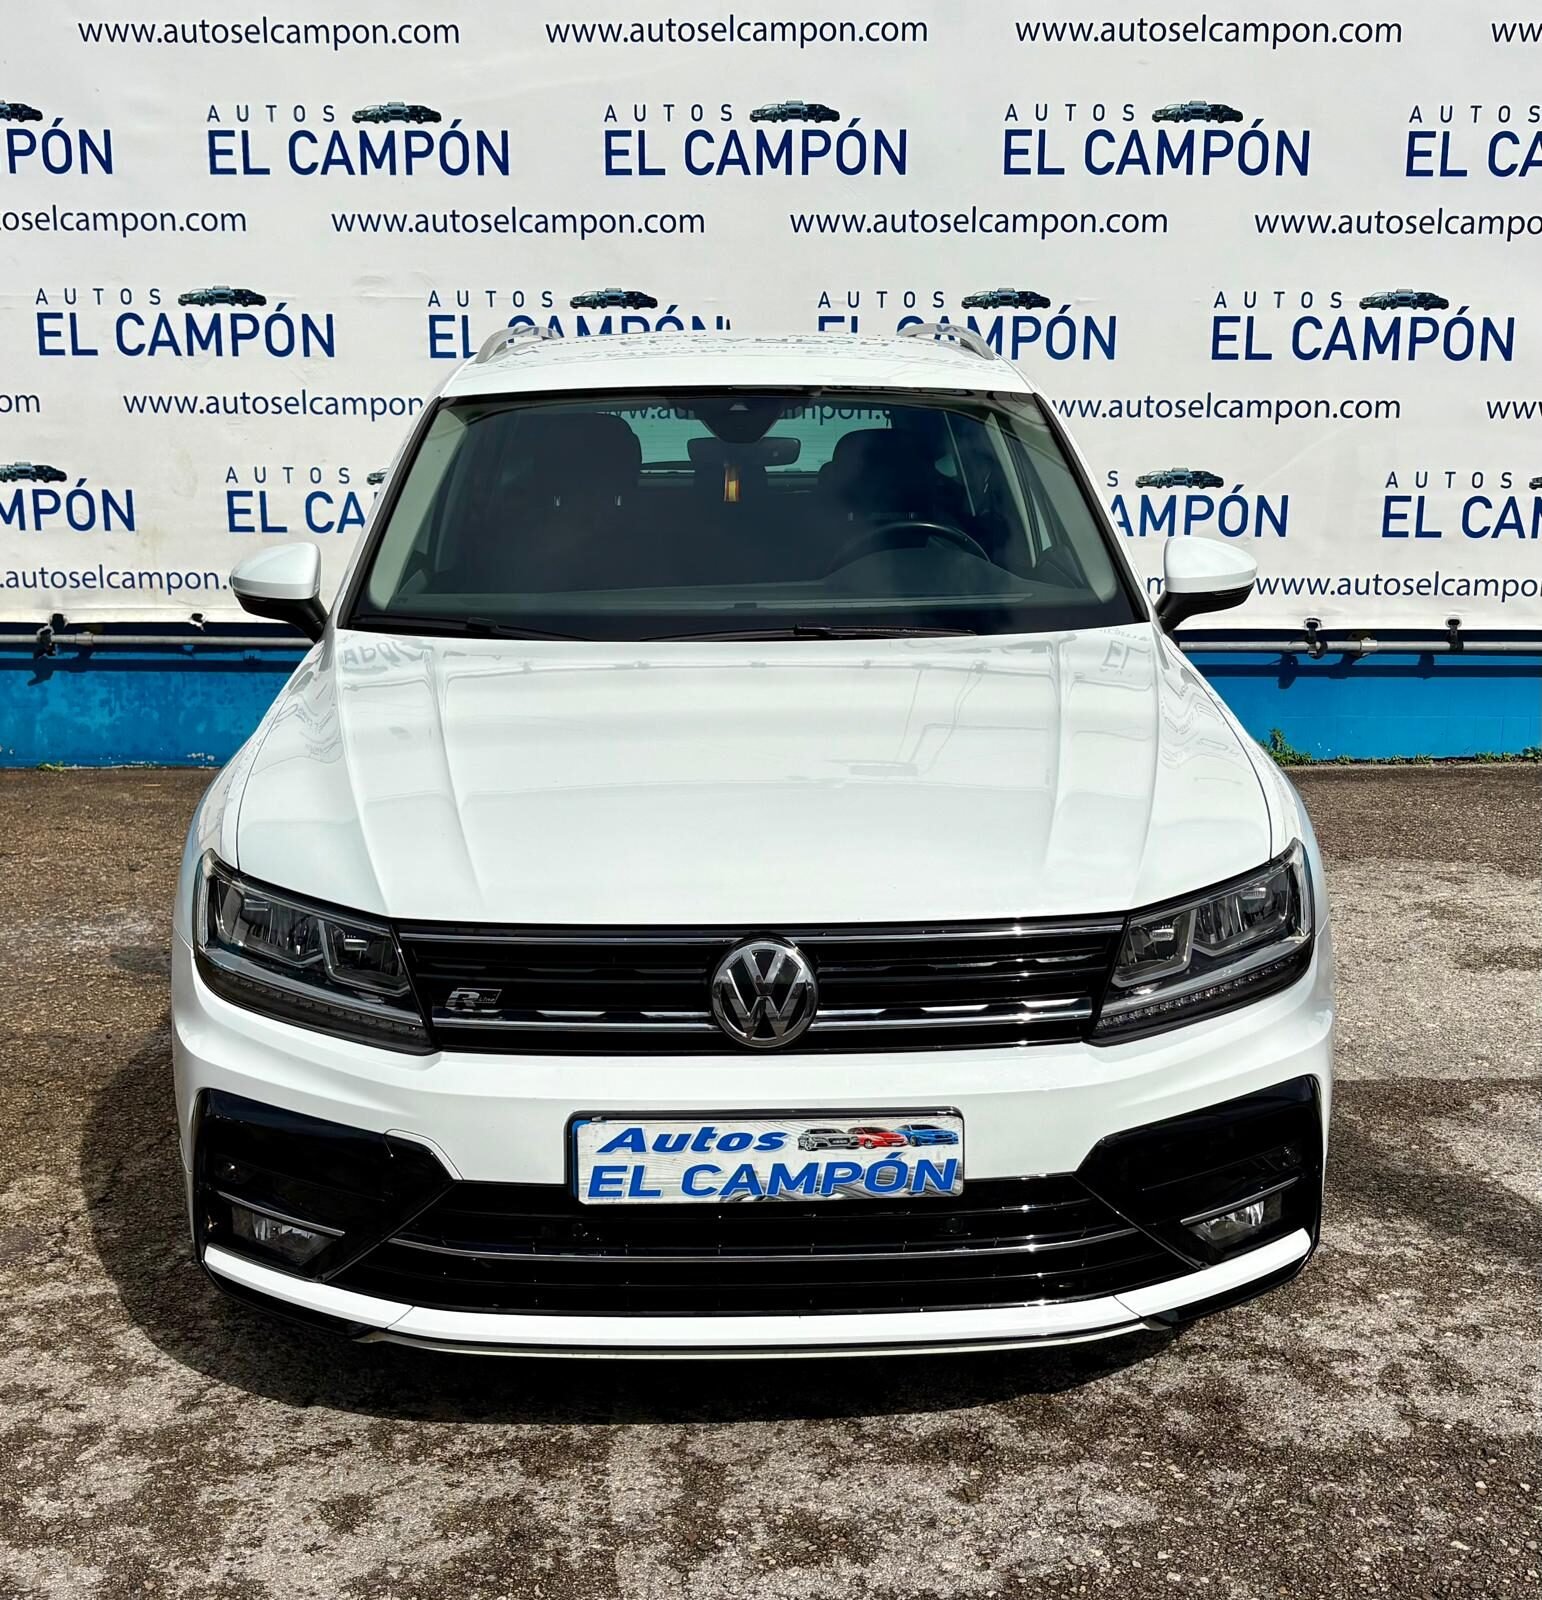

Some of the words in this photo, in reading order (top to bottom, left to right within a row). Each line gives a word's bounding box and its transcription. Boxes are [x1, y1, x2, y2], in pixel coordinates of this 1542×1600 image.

[78, 14, 460, 52] www.autoselcampon.com
[546, 13, 928, 50] www.autoselcampon.com
[1016, 14, 1402, 50] www.autoselcampon.com
[207, 104, 335, 123] AUTOS
[604, 103, 733, 123] AUTOS
[1005, 103, 1135, 122] AUTOS
[1408, 105, 1541, 124] AUTOS
[6, 117, 113, 175] PÓN
[208, 129, 271, 176] EL
[288, 118, 510, 177] CAMPÓN
[604, 129, 666, 176] EL
[684, 117, 907, 176] CAMPÓN
[1003, 128, 1065, 176] EL
[1084, 118, 1310, 177] CAMPÓN
[1405, 130, 1468, 177] EL
[0, 204, 247, 238] oselcampon.com
[332, 206, 705, 241] www.autoselcampon.com
[790, 205, 1168, 240] www.autoselcampon.com
[1255, 207, 1542, 243] www.autoselcampo
[36, 287, 161, 305] AUTOS
[428, 289, 553, 308] AUTOS
[818, 290, 945, 309] AUTOS
[1214, 290, 1342, 309] AUTOS
[37, 311, 99, 357] EL
[116, 302, 335, 358] CAMPÓN
[429, 314, 478, 359] EL
[1211, 315, 1273, 361] EL
[1291, 305, 1515, 362] CAMPÓN
[1486, 400, 1542, 420] ww
[226, 466, 350, 485] AUTOS
[1385, 471, 1512, 489] AUTOS
[226, 490, 288, 534] EL
[305, 490, 379, 534] CA
[1381, 495, 1442, 539] EL
[0, 564, 234, 597] .autoselcampon.
[1256, 570, 1542, 603] www.autoselcampo
[596, 1126, 789, 1154] Autos
[586, 1164, 664, 1199] EL
[680, 1152, 959, 1199] CAMPÓN
